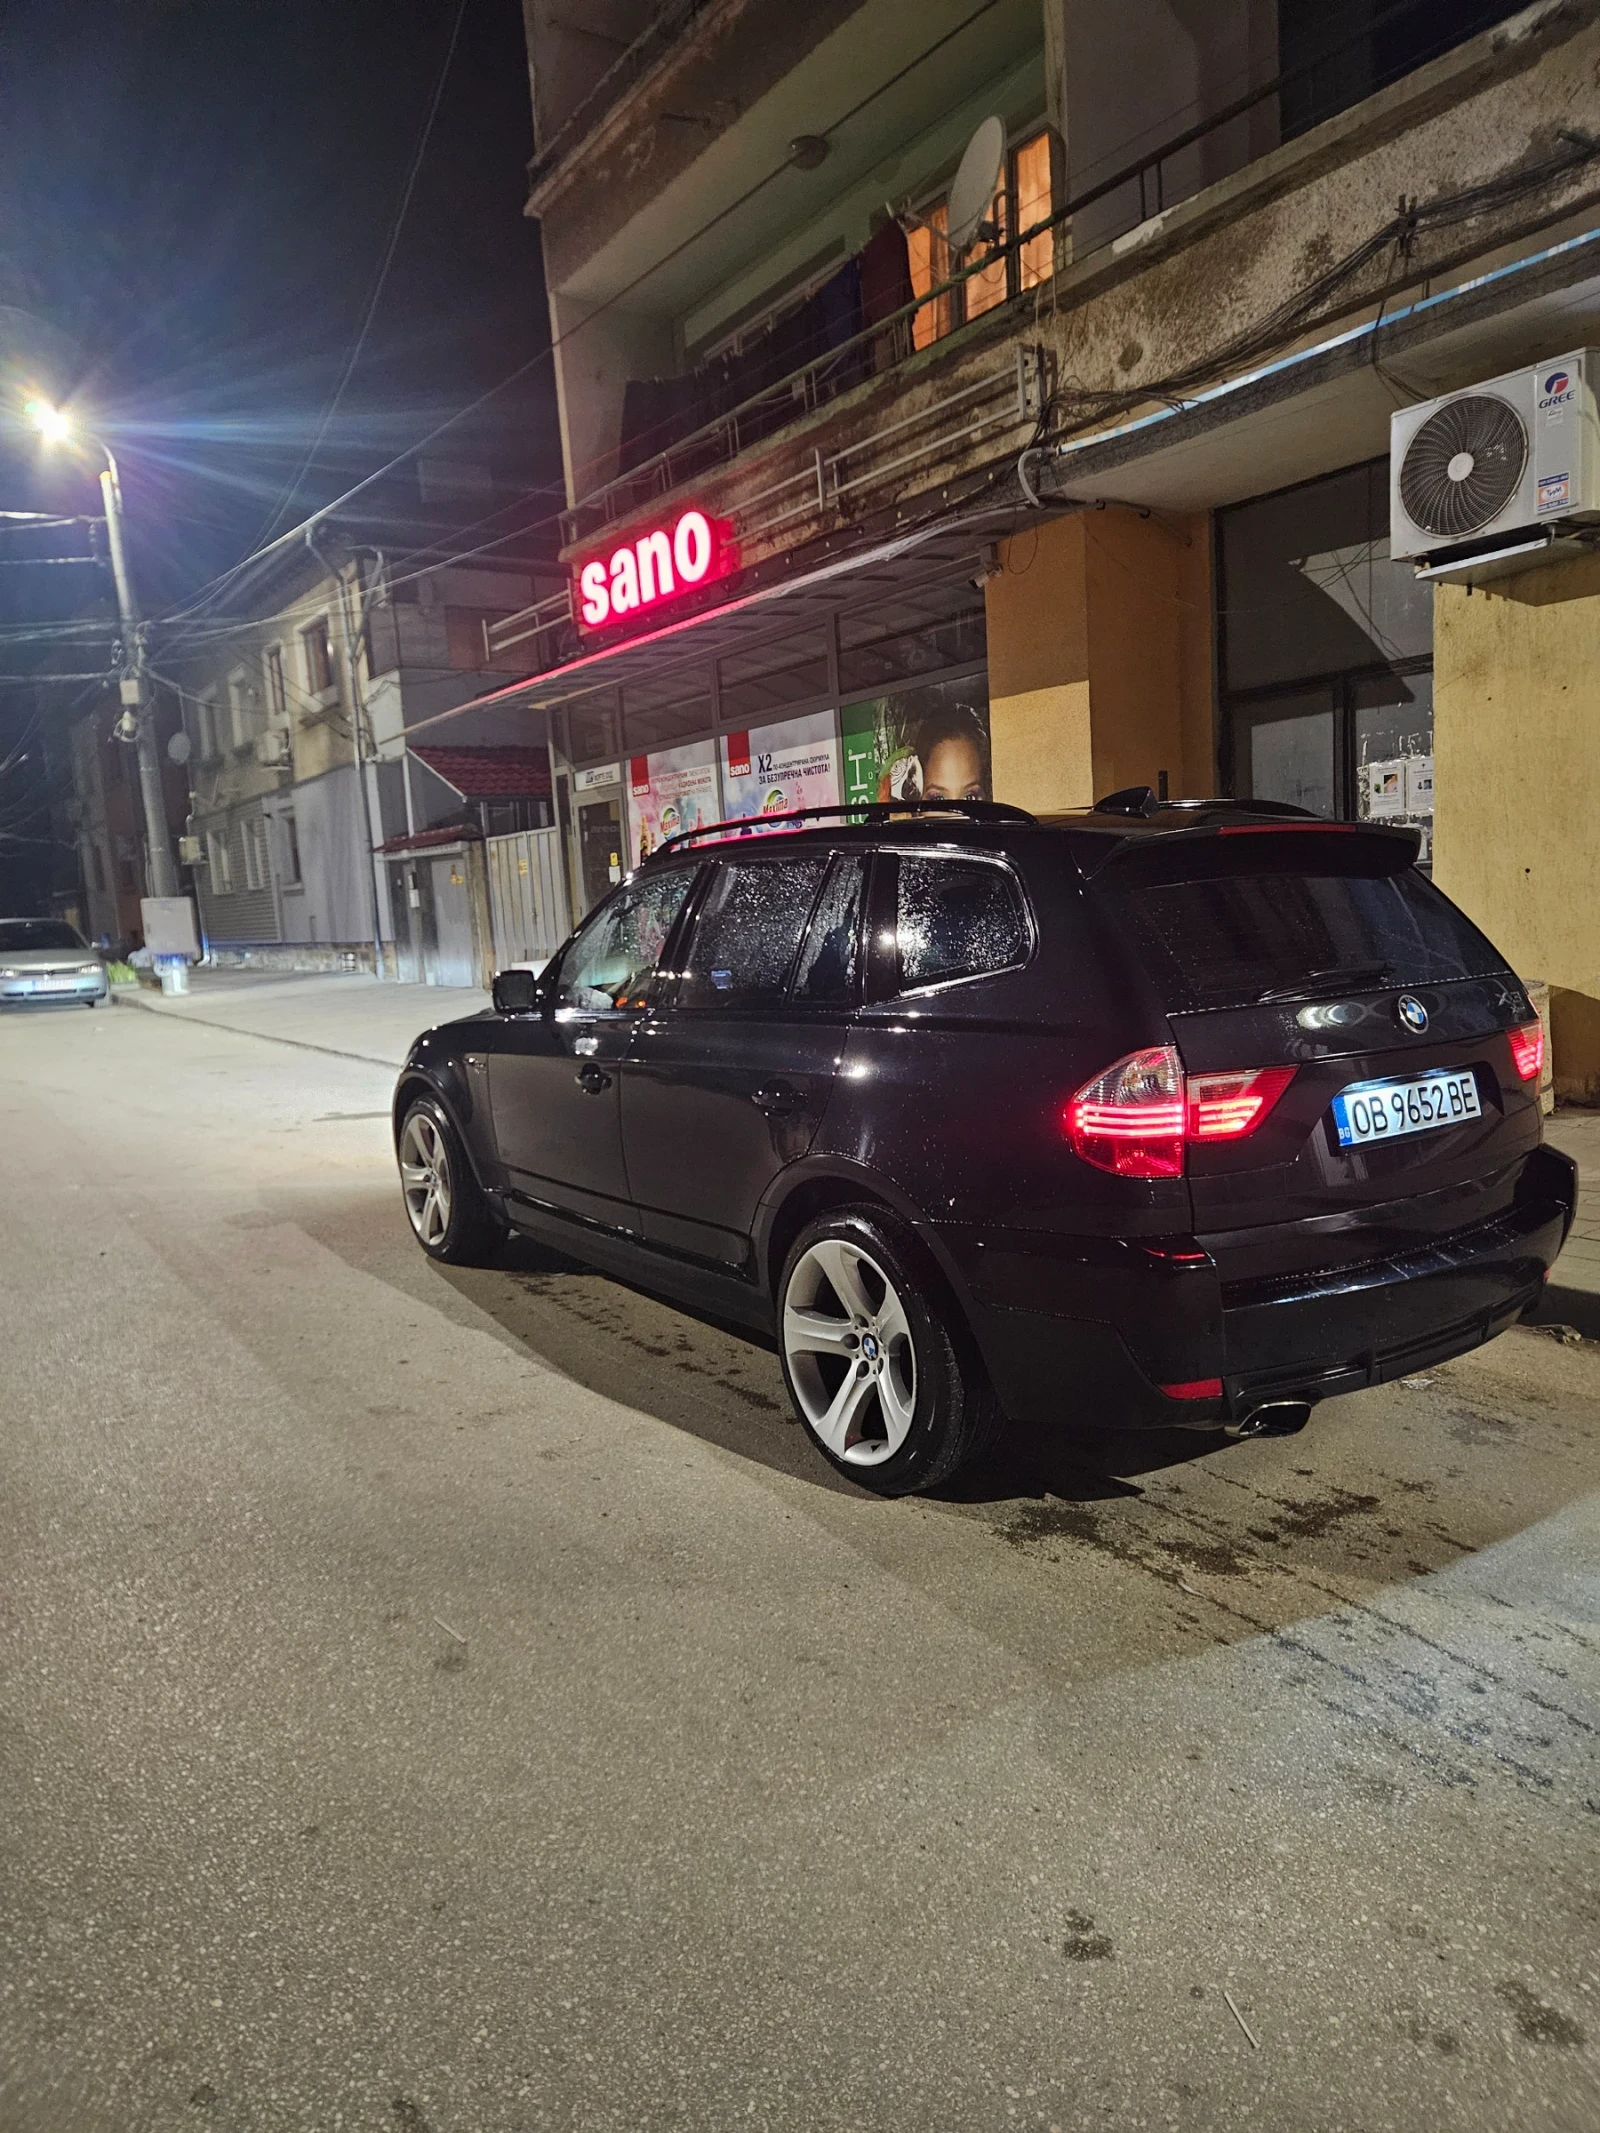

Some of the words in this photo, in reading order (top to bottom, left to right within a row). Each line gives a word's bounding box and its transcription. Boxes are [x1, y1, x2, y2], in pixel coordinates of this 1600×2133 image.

[1538, 389, 1576, 409] GREE
[580, 511, 711, 625] sano
[730, 764, 750, 777] sano
[758, 775, 767, 785] ЗА
[767, 769, 803, 784] БЕЗУПРЕЧНА
[803, 763, 831, 777] ЧИСТОТА!
[1338, 1126, 1351, 1139] BG
